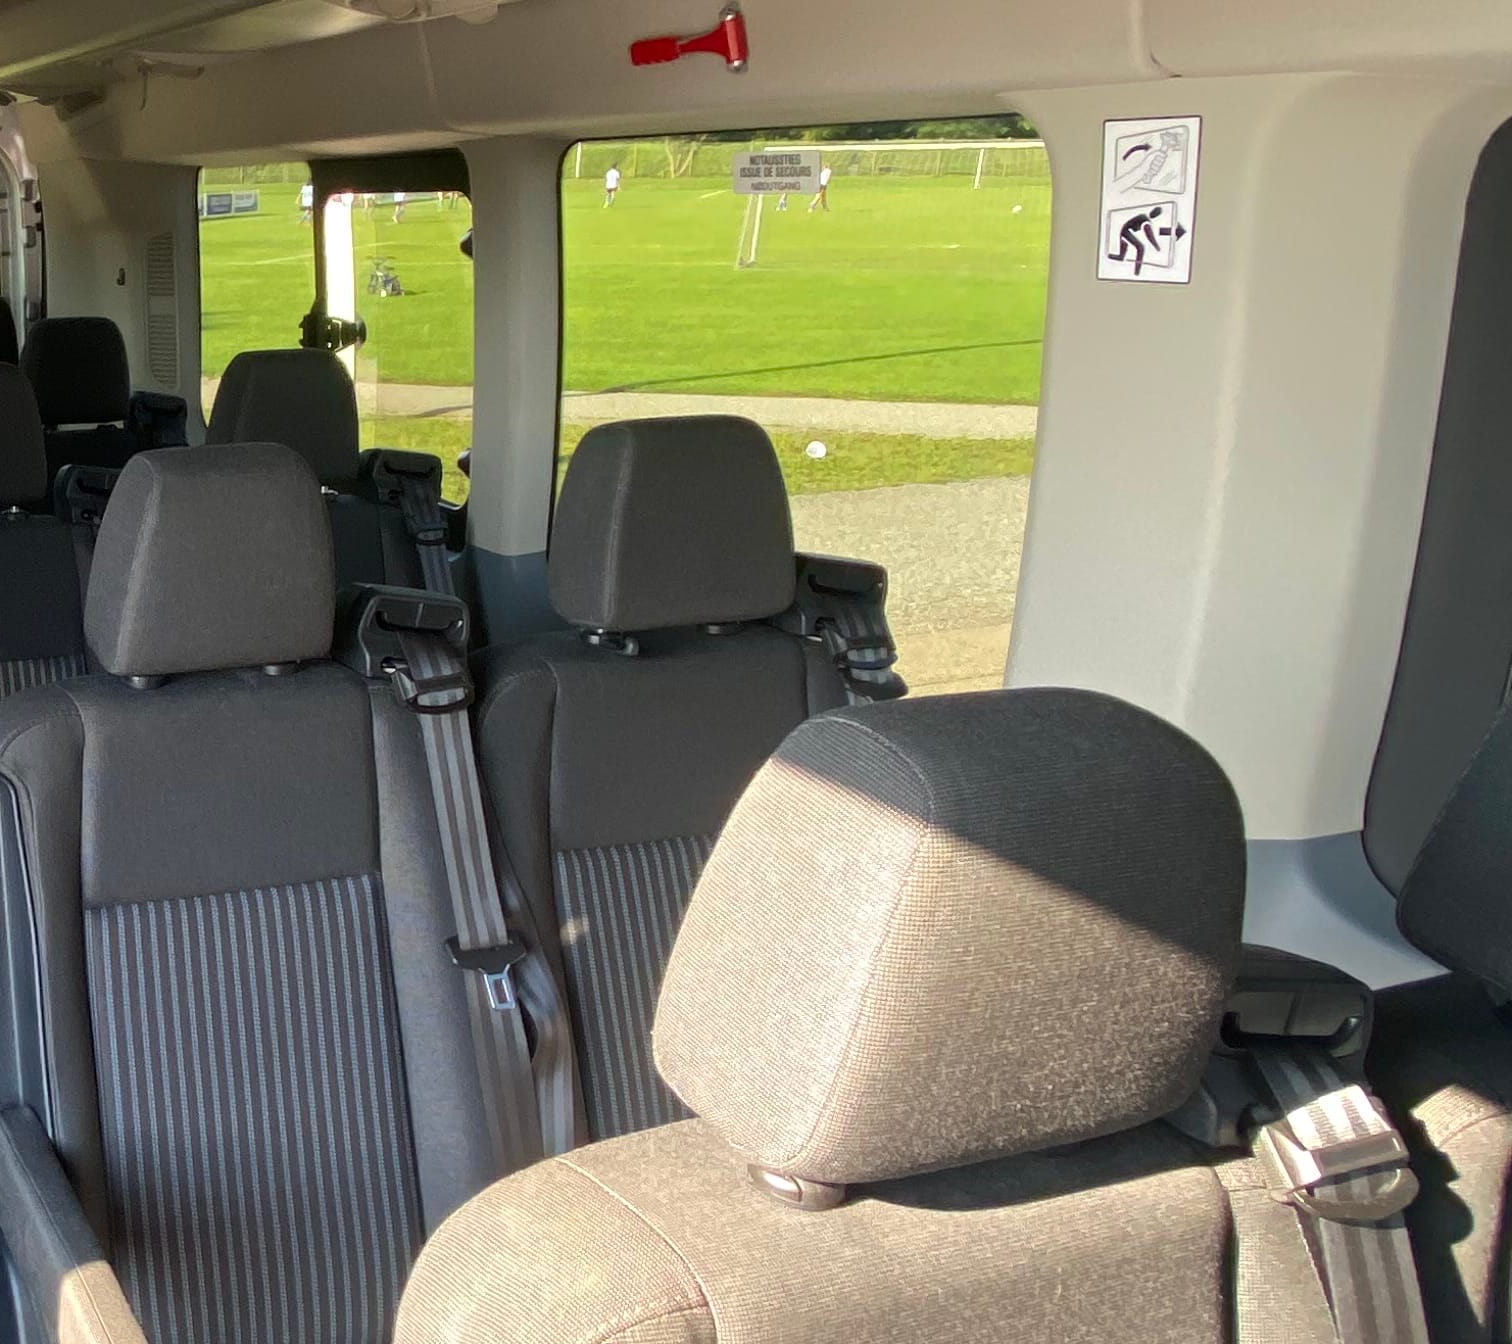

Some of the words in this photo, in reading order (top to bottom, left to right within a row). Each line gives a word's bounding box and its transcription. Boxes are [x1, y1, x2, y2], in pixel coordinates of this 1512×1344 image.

[750, 154, 801, 165] NOTAUSSTIEG
[740, 167, 761, 178] ISSUE
[763, 167, 774, 177] DE
[776, 166, 812, 177] SECOURS
